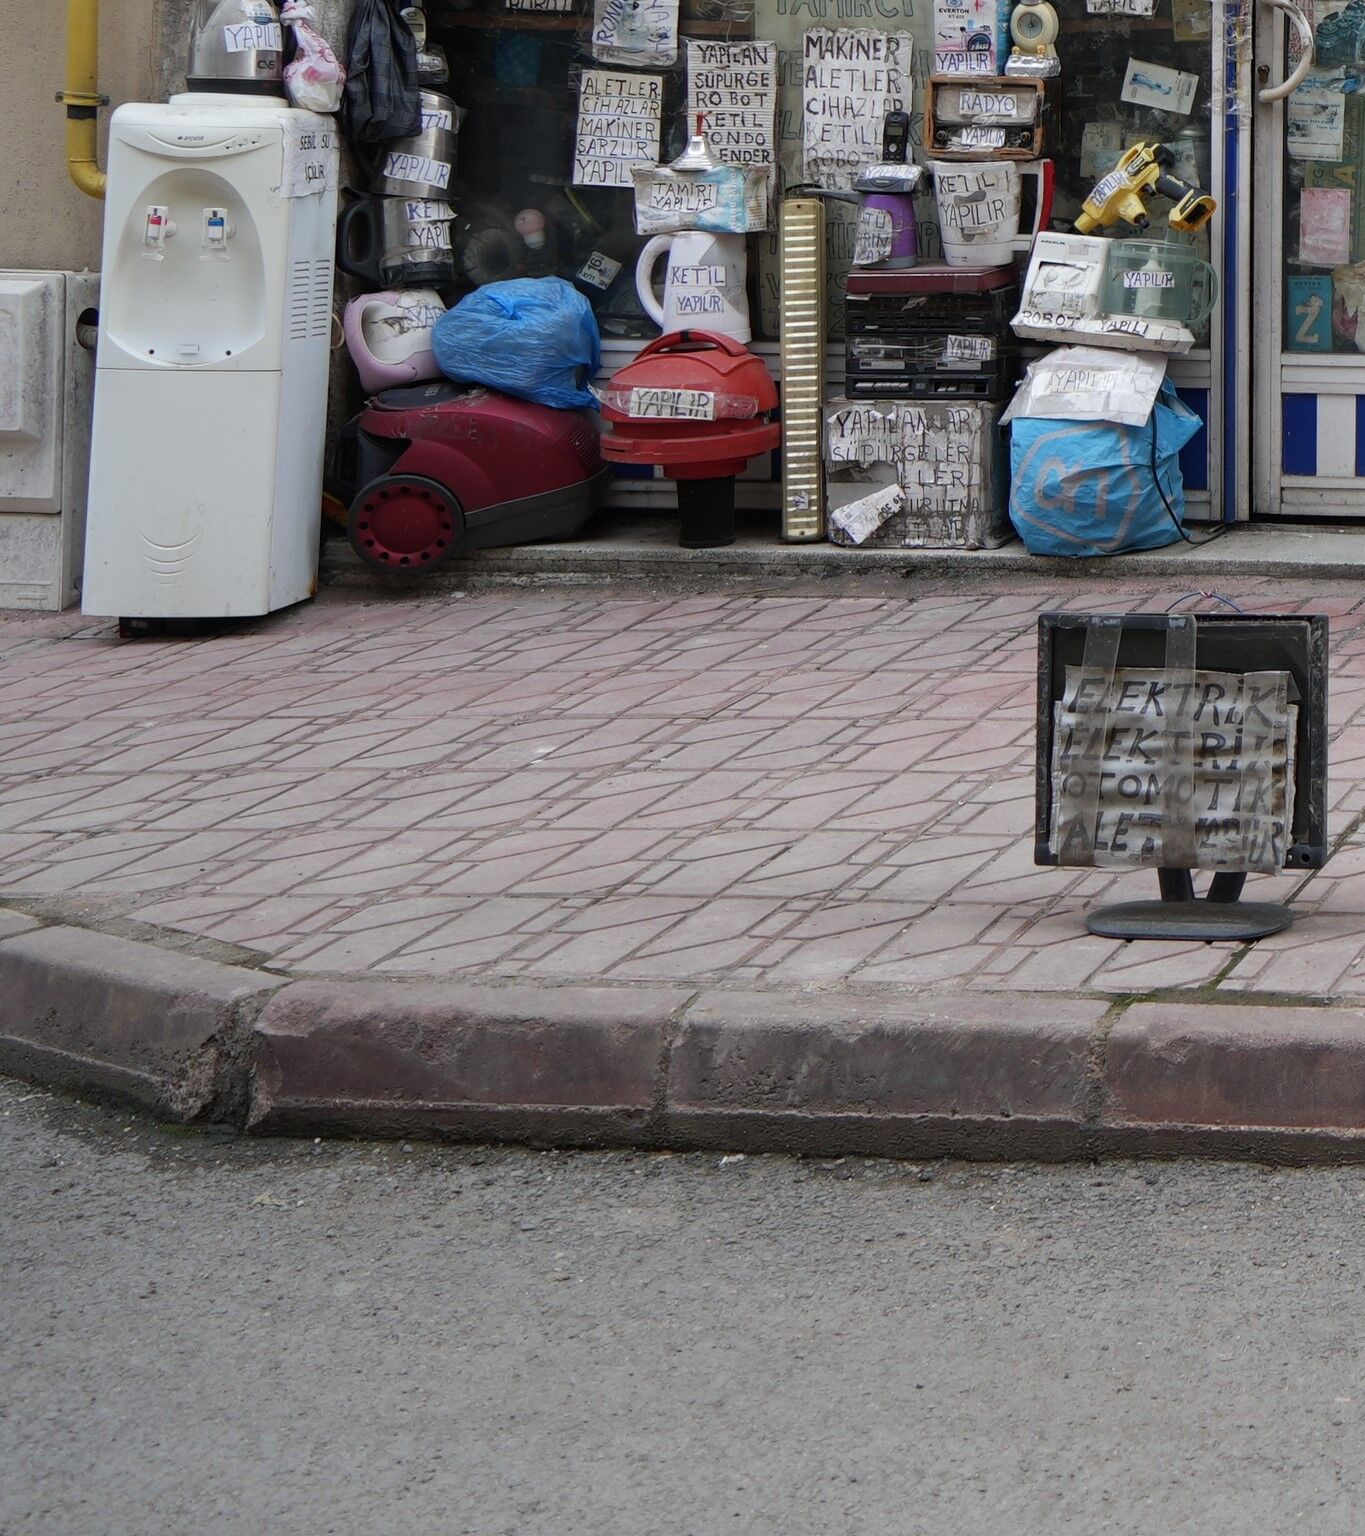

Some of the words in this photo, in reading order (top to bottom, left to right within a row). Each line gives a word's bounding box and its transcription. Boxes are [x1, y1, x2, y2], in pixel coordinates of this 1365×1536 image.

[805, 33, 900, 63] MAKİNER
[936, 52, 988, 72] YAPILIR
[805, 67, 901, 94] ALETLER
[582, 97, 660, 115] CİHAZLAR
[697, 92, 768, 108] ROBOT
[961, 94, 1014, 112] RADYO
[321, 136, 332, 149] SU
[962, 130, 1004, 146] YAPILIR
[388, 153, 450, 184] YAPILIR
[654, 183, 714, 197] TAMİRİ
[943, 201, 1004, 227] YAPILIR
[671, 266, 725, 286] KETİL
[677, 293, 722, 313] YAPILIR
[634, 389, 714, 418] YAPILIR
[1068, 677, 1277, 729] ELEKTRİK
